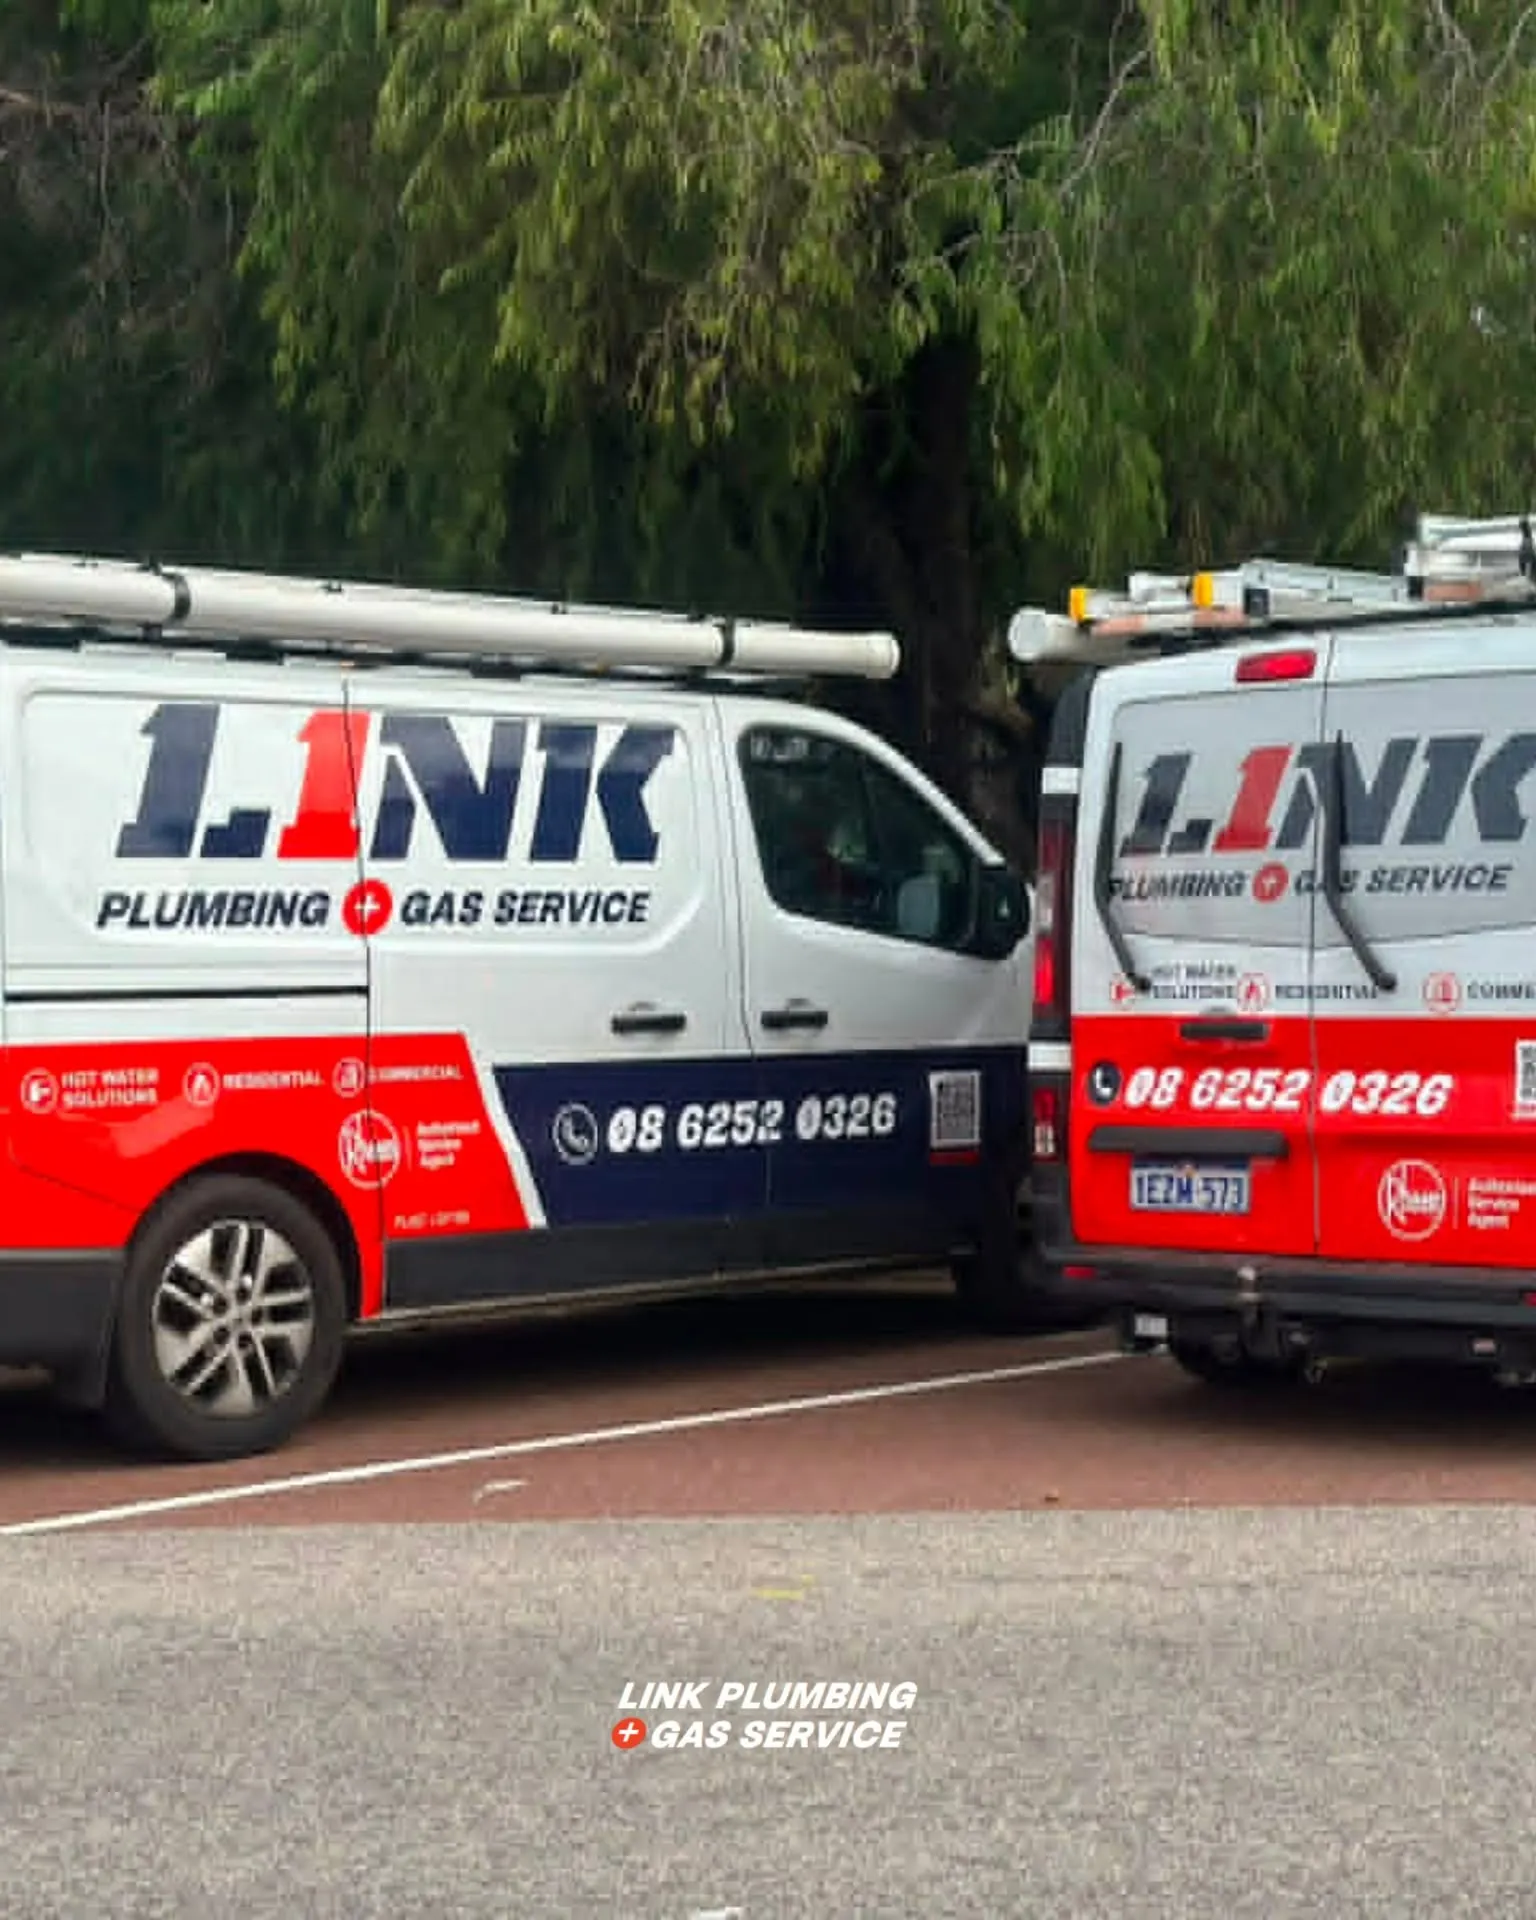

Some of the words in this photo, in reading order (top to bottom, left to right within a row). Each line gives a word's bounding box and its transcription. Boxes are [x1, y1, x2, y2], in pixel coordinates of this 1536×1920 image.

[1295, 869, 1360, 896] GS
[1365, 864, 1513, 894] SERVICE
[97, 890, 329, 928] PLUMBING
[400, 890, 483, 925] GAS
[493, 890, 649, 924] SERVICE
[1124, 1066, 1185, 1108] 08
[1190, 1067, 1311, 1111] 6252
[1318, 1070, 1454, 1116] 0326
[607, 1105, 666, 1153] 08
[676, 1099, 786, 1149] 6252
[795, 1093, 897, 1141] 0326
